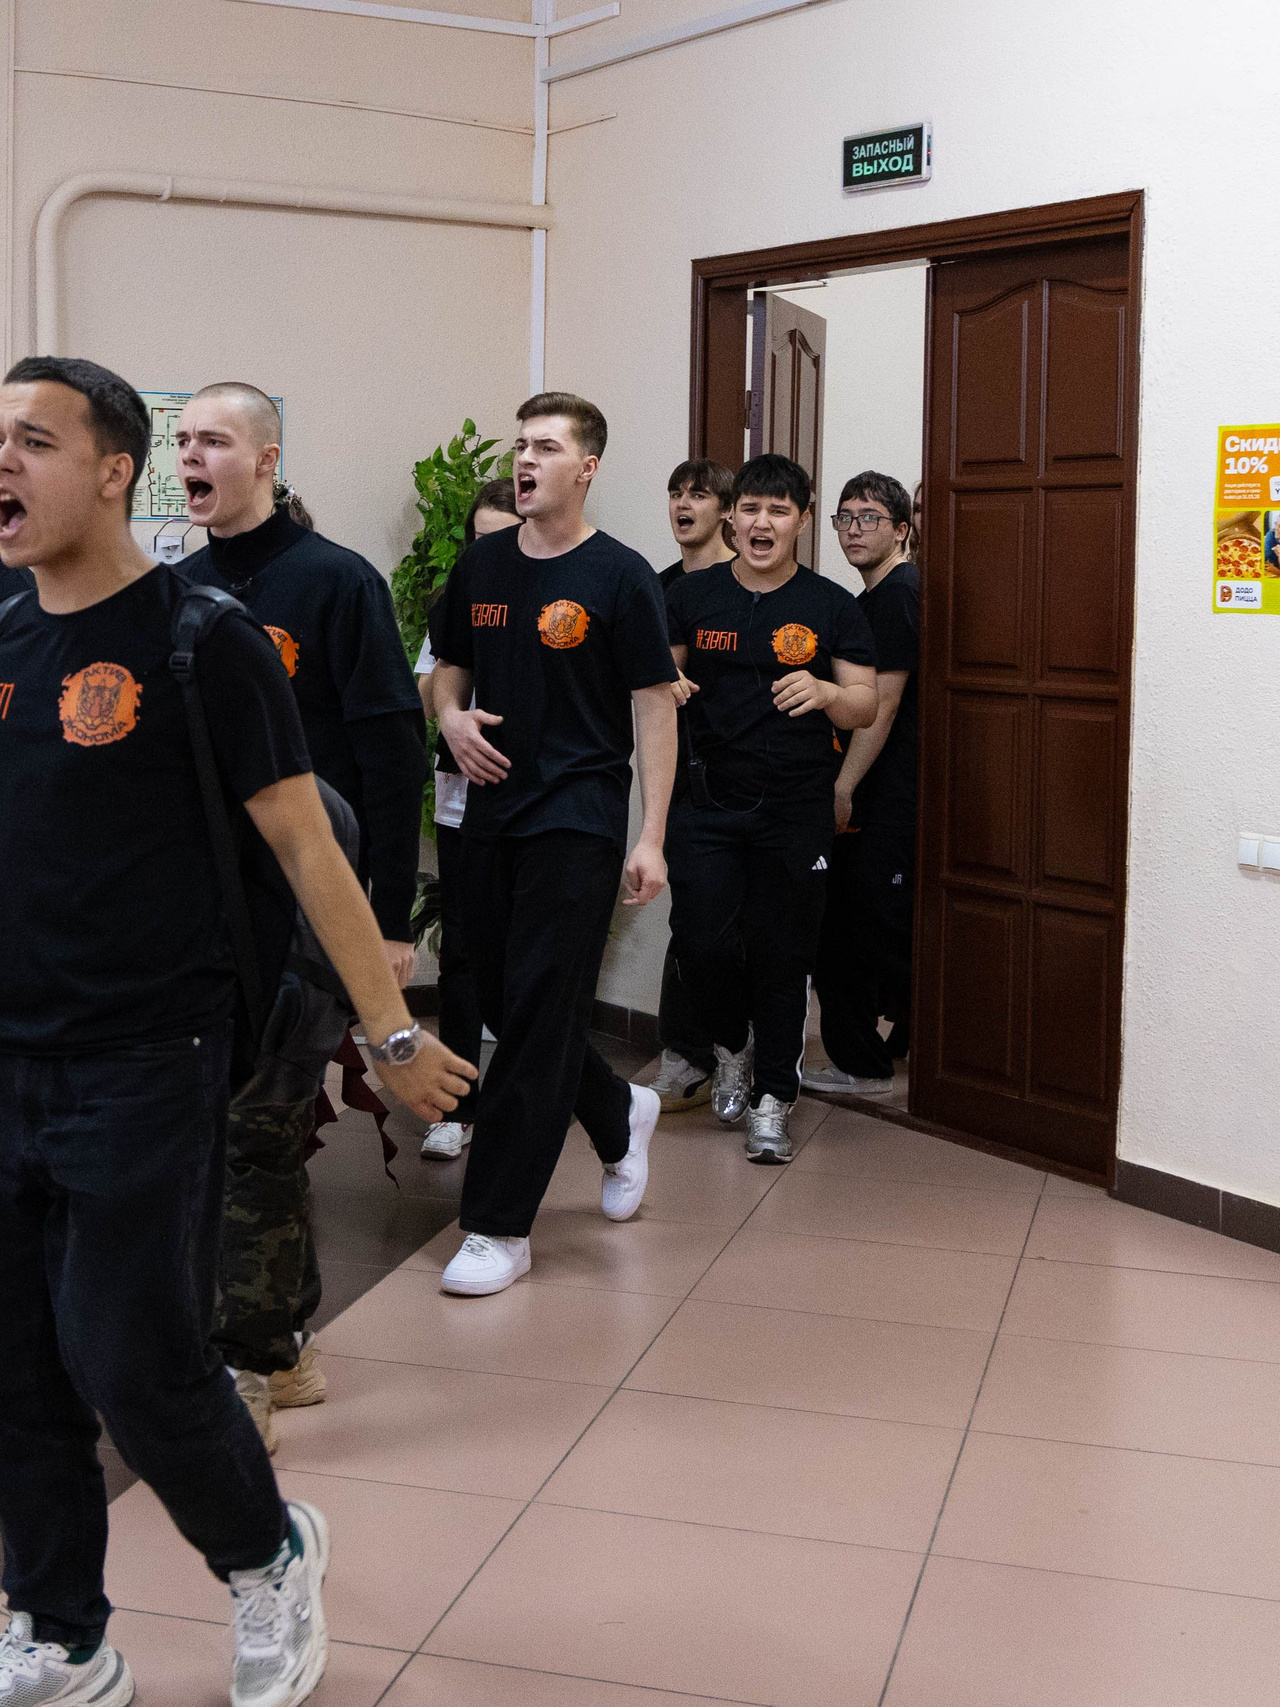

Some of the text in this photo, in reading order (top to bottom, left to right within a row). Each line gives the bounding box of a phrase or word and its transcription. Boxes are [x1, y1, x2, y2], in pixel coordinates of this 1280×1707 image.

[852, 135, 914, 159] ЗАПАСНЫЙ
[852, 154, 913, 177] ВЫХОД
[1225, 435, 1280, 455] Скид
[1224, 456, 1269, 475] 10%
[83, 666, 127, 684] АКТИВ
